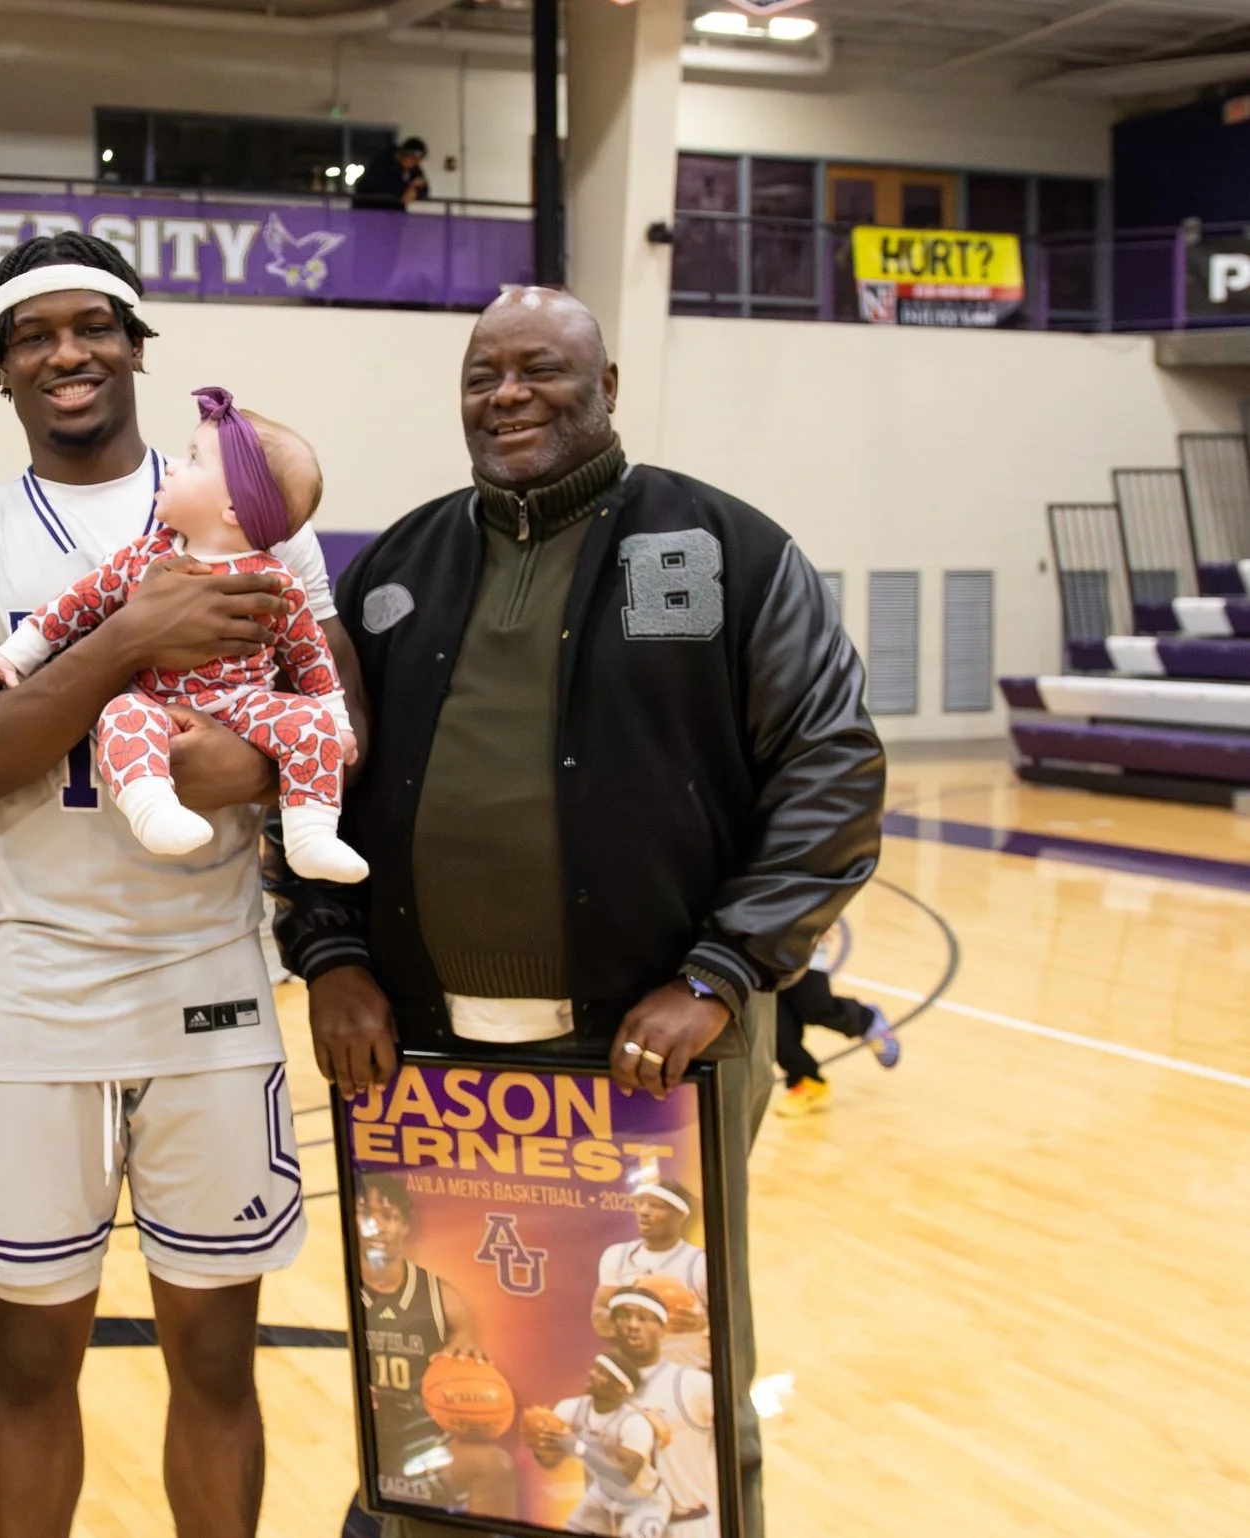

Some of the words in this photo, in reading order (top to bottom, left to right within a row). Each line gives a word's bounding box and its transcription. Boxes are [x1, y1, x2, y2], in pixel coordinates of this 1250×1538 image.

[881, 236, 994, 278] HURT?
[618, 527, 724, 642] B
[352, 1065, 613, 1140] JASON
[353, 1121, 674, 1183] ERNEST
[406, 1174, 445, 1194] AVILA
[449, 1177, 491, 1199] MEN'S
[495, 1182, 585, 1208] BASKETBALL
[375, 1354, 411, 1391] 10
